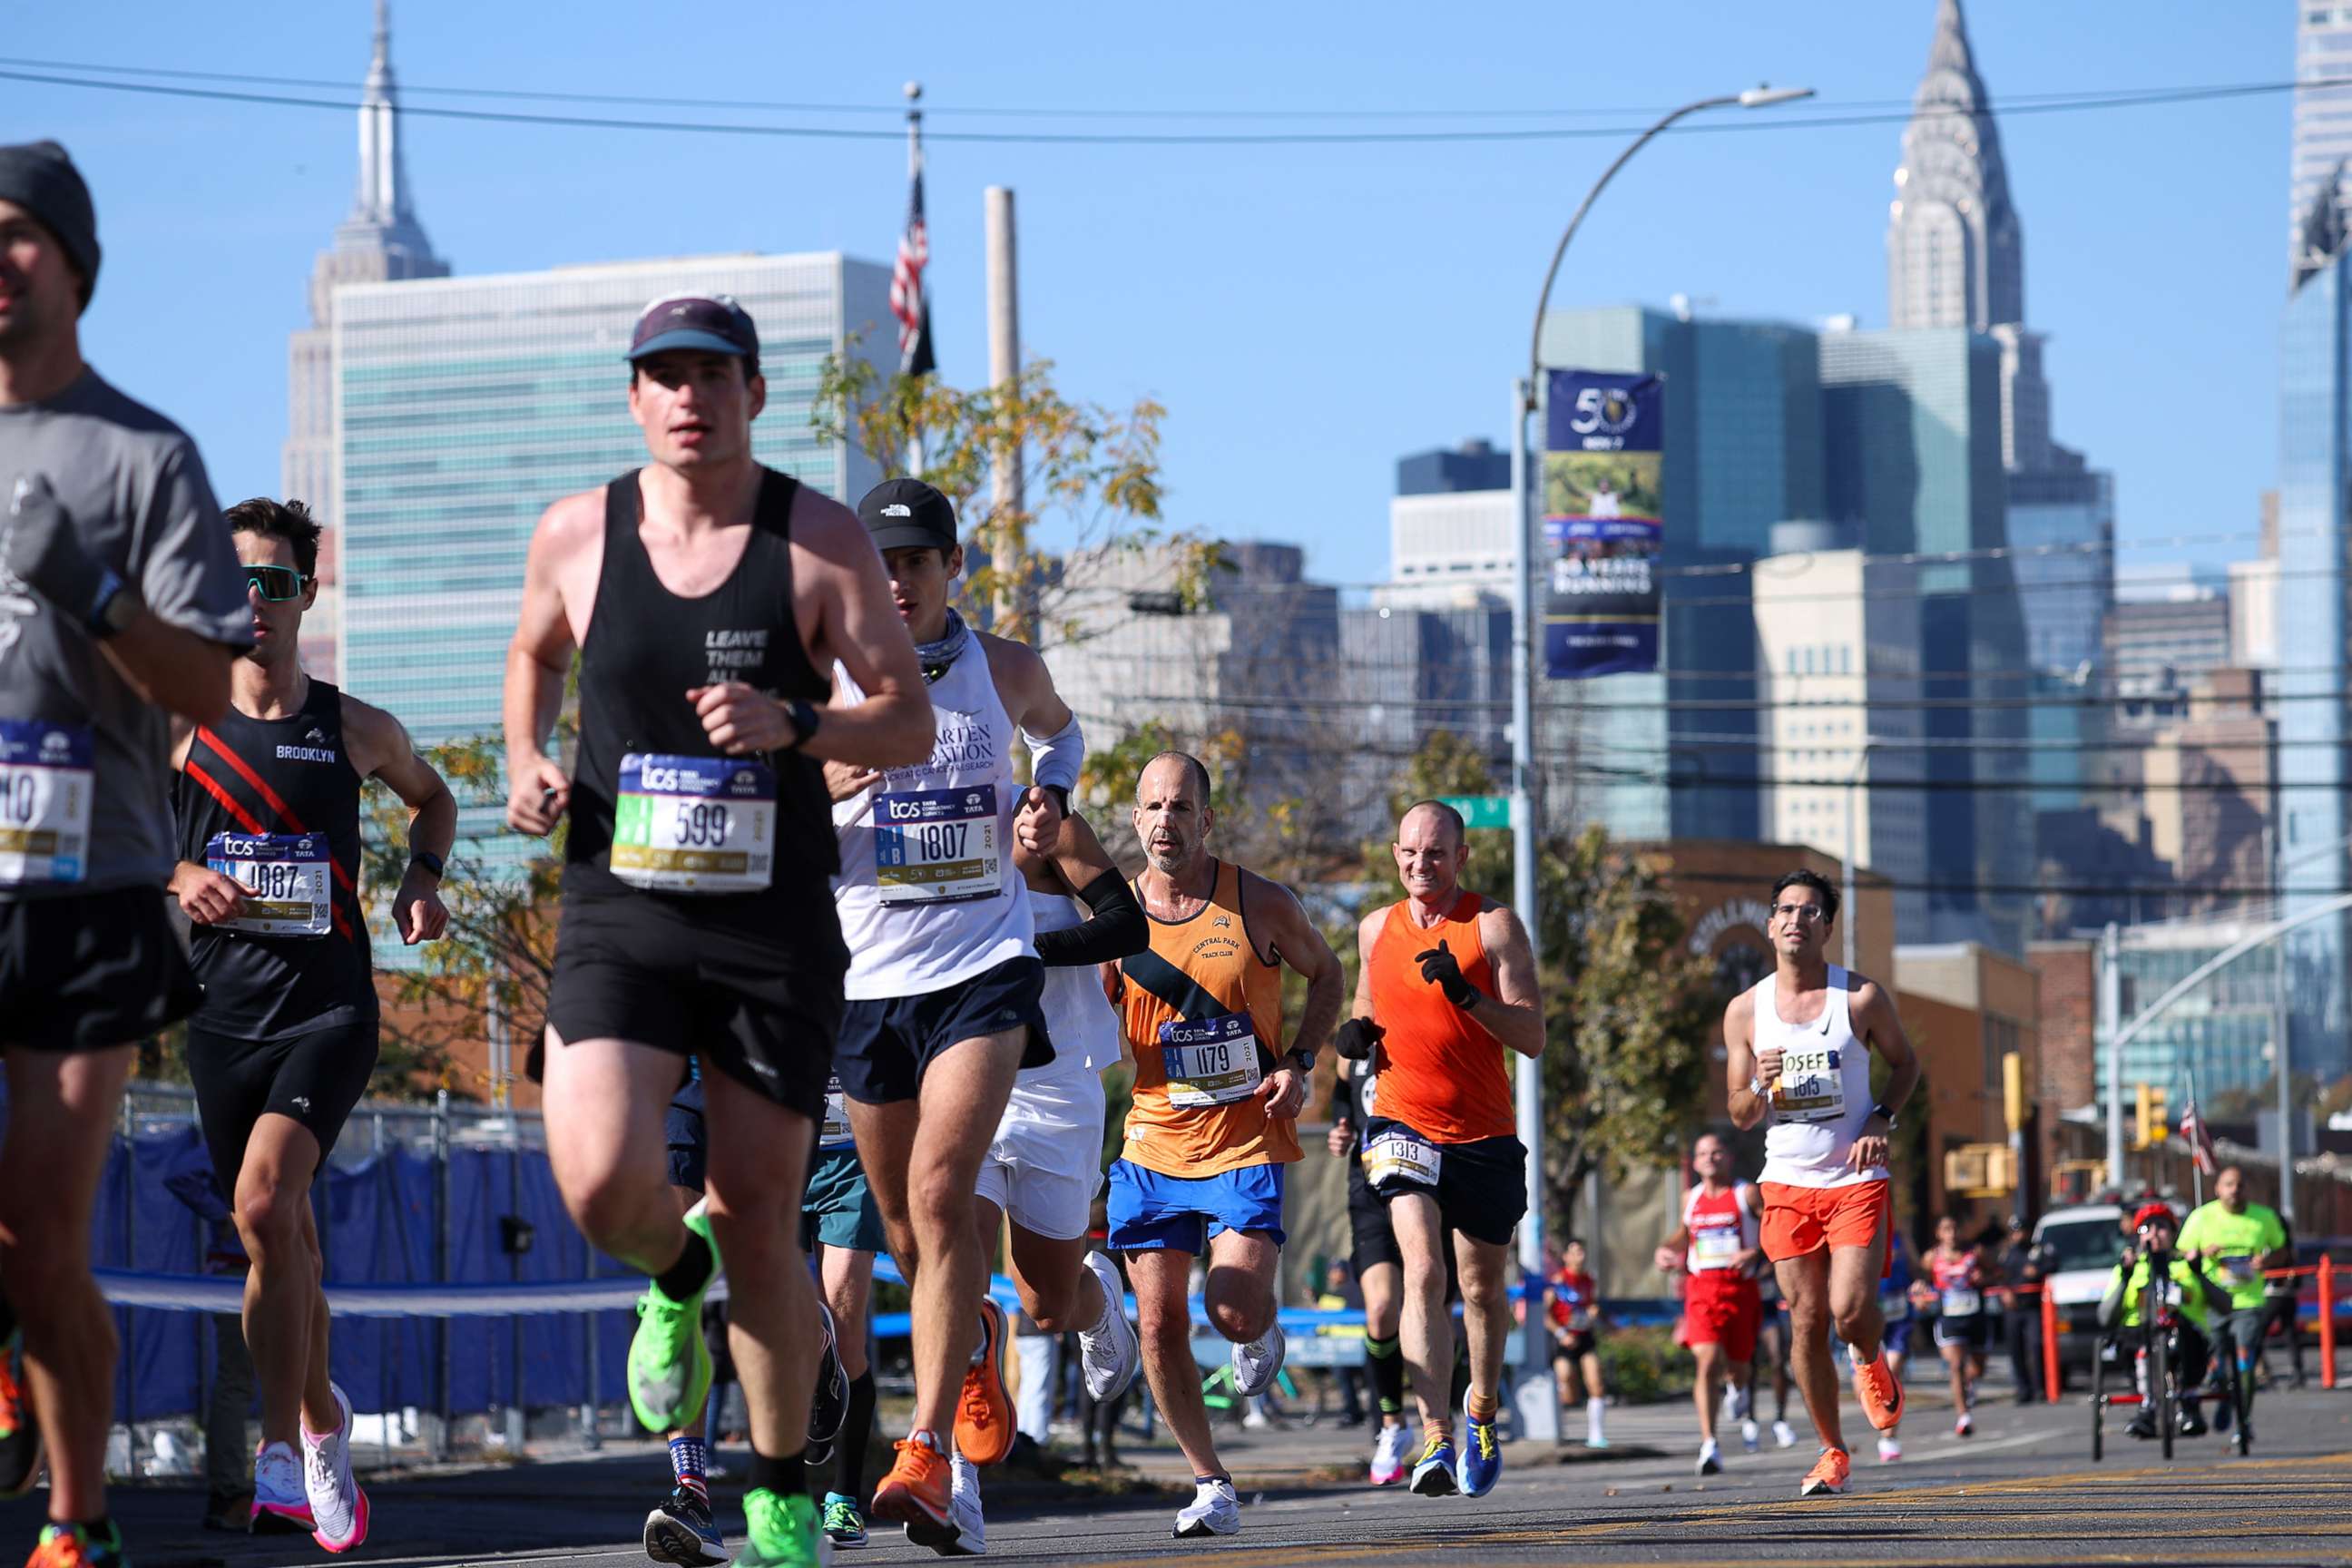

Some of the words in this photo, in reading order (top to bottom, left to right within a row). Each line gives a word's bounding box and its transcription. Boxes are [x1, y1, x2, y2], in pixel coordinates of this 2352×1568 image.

[705, 630, 768, 648] LEAVE
[705, 650, 764, 667] THEM
[935, 723, 992, 744] ARTEN
[276, 745, 335, 763] BROOKLYN
[642, 762, 678, 791] tcs
[889, 799, 920, 818] tcs
[964, 805, 984, 814] TATA
[676, 803, 727, 847] 599
[224, 836, 254, 856] tcs
[919, 822, 968, 861] 1807
[251, 864, 299, 899] 1087
[315, 869, 323, 895] 2021
[1192, 936, 1222, 954] CENTRAL
[1223, 937, 1240, 950] PARK
[1201, 951, 1219, 959] TRACK
[1171, 1024, 1194, 1043] tcs
[1226, 1029, 1242, 1037] TATA
[1196, 1044, 1230, 1075] 1179
[1243, 1042, 1252, 1063] 2021
[1785, 1053, 1825, 1072] OSEF
[1793, 1074, 1820, 1097] 1615
[1391, 1142, 1418, 1161] 1313
